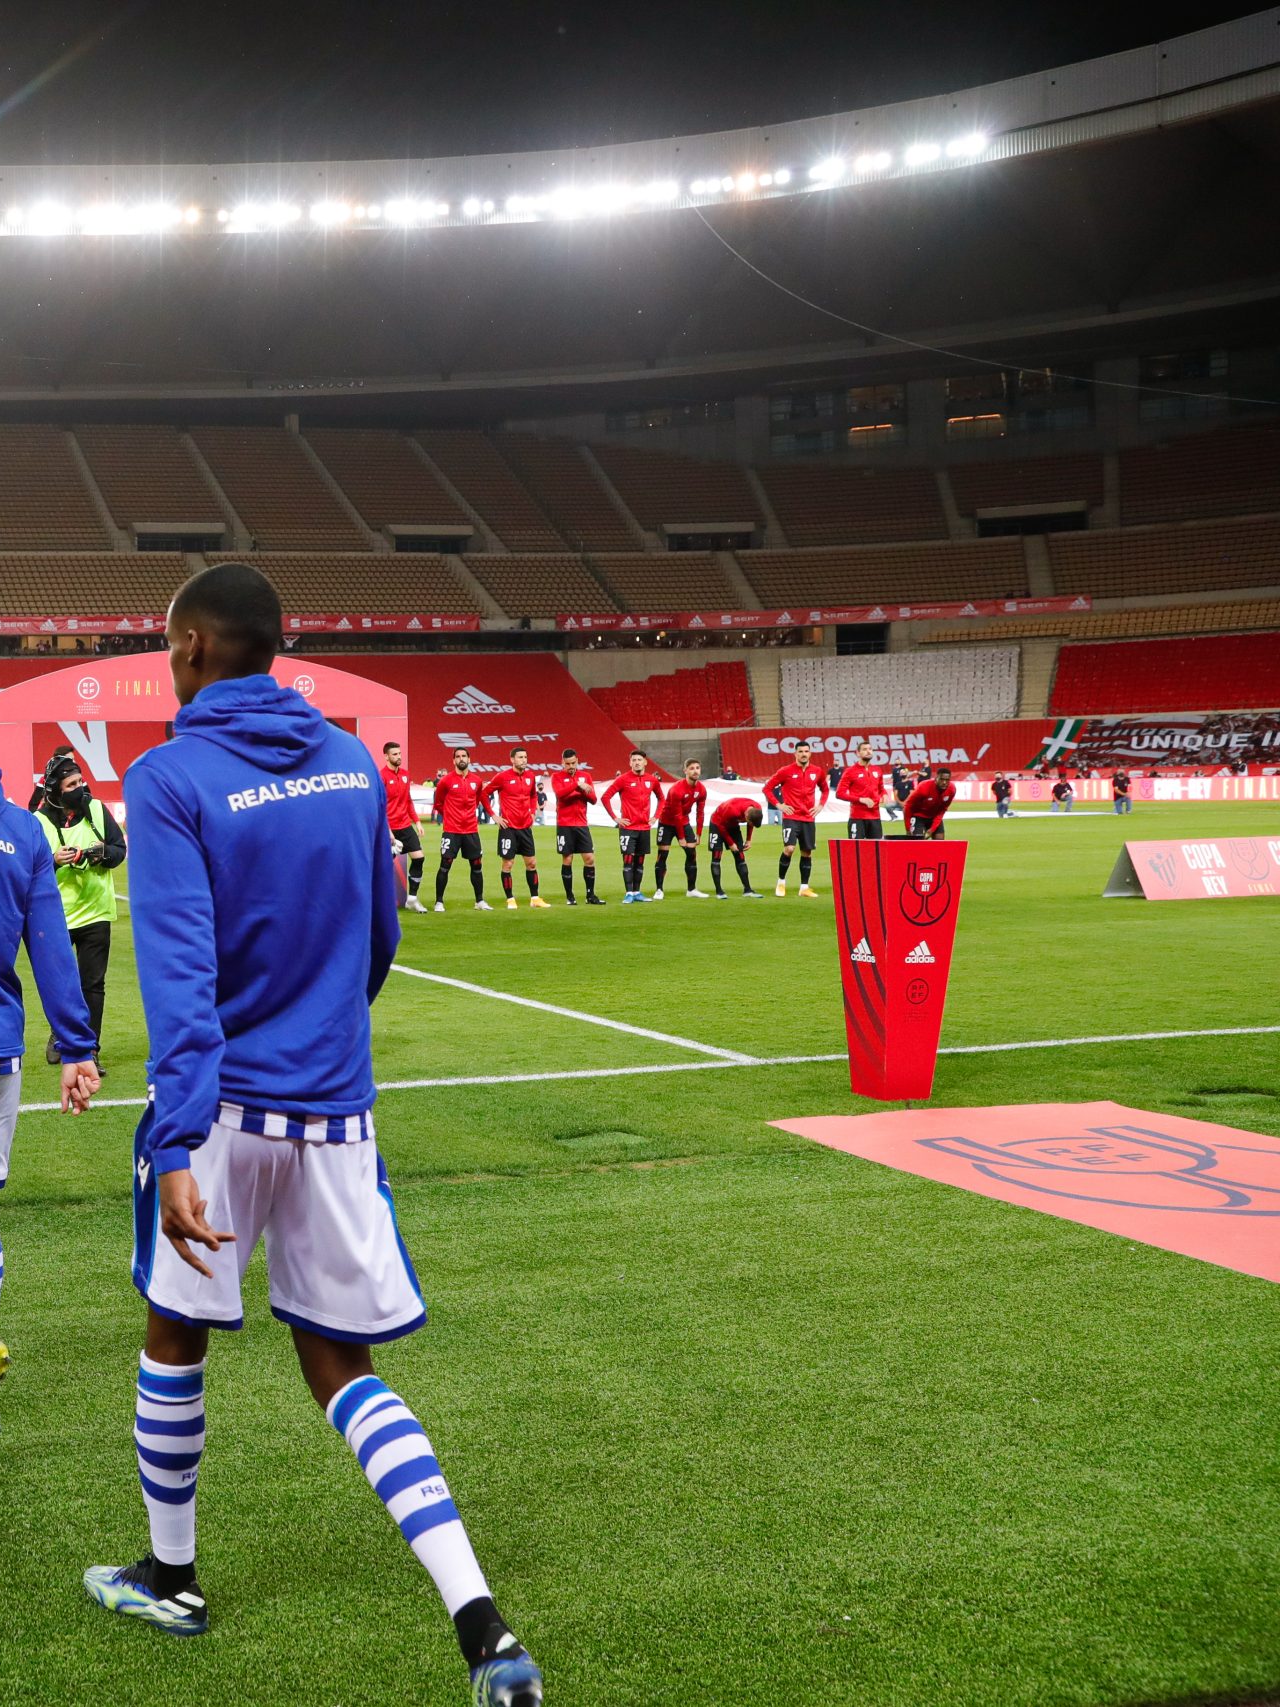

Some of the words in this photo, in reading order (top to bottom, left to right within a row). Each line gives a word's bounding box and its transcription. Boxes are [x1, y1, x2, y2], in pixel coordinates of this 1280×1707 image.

[302, 618, 327, 626] SEAT
[373, 618, 397, 626] SEAT
[444, 618, 467, 626] SEAT
[116, 680, 160, 696] FINAL
[442, 703, 516, 715] adidas
[480, 733, 559, 743] SEAT
[757, 733, 926, 754] GOGOAREN
[1130, 733, 1253, 750] UNIQUE
[227, 784, 285, 812] REAL
[284, 772, 369, 798] SOCIEDAD
[658, 827, 664, 837] 5
[851, 823, 857, 833] 4
[501, 838, 512, 849] 18
[620, 836, 630, 846] 27
[709, 833, 718, 844] 12
[1181, 843, 1226, 870] COPA
[1201, 875, 1229, 896] REY
[851, 952, 876, 963] adidas
[905, 954, 935, 964] adidas
[420, 1485, 445, 1497] RS
